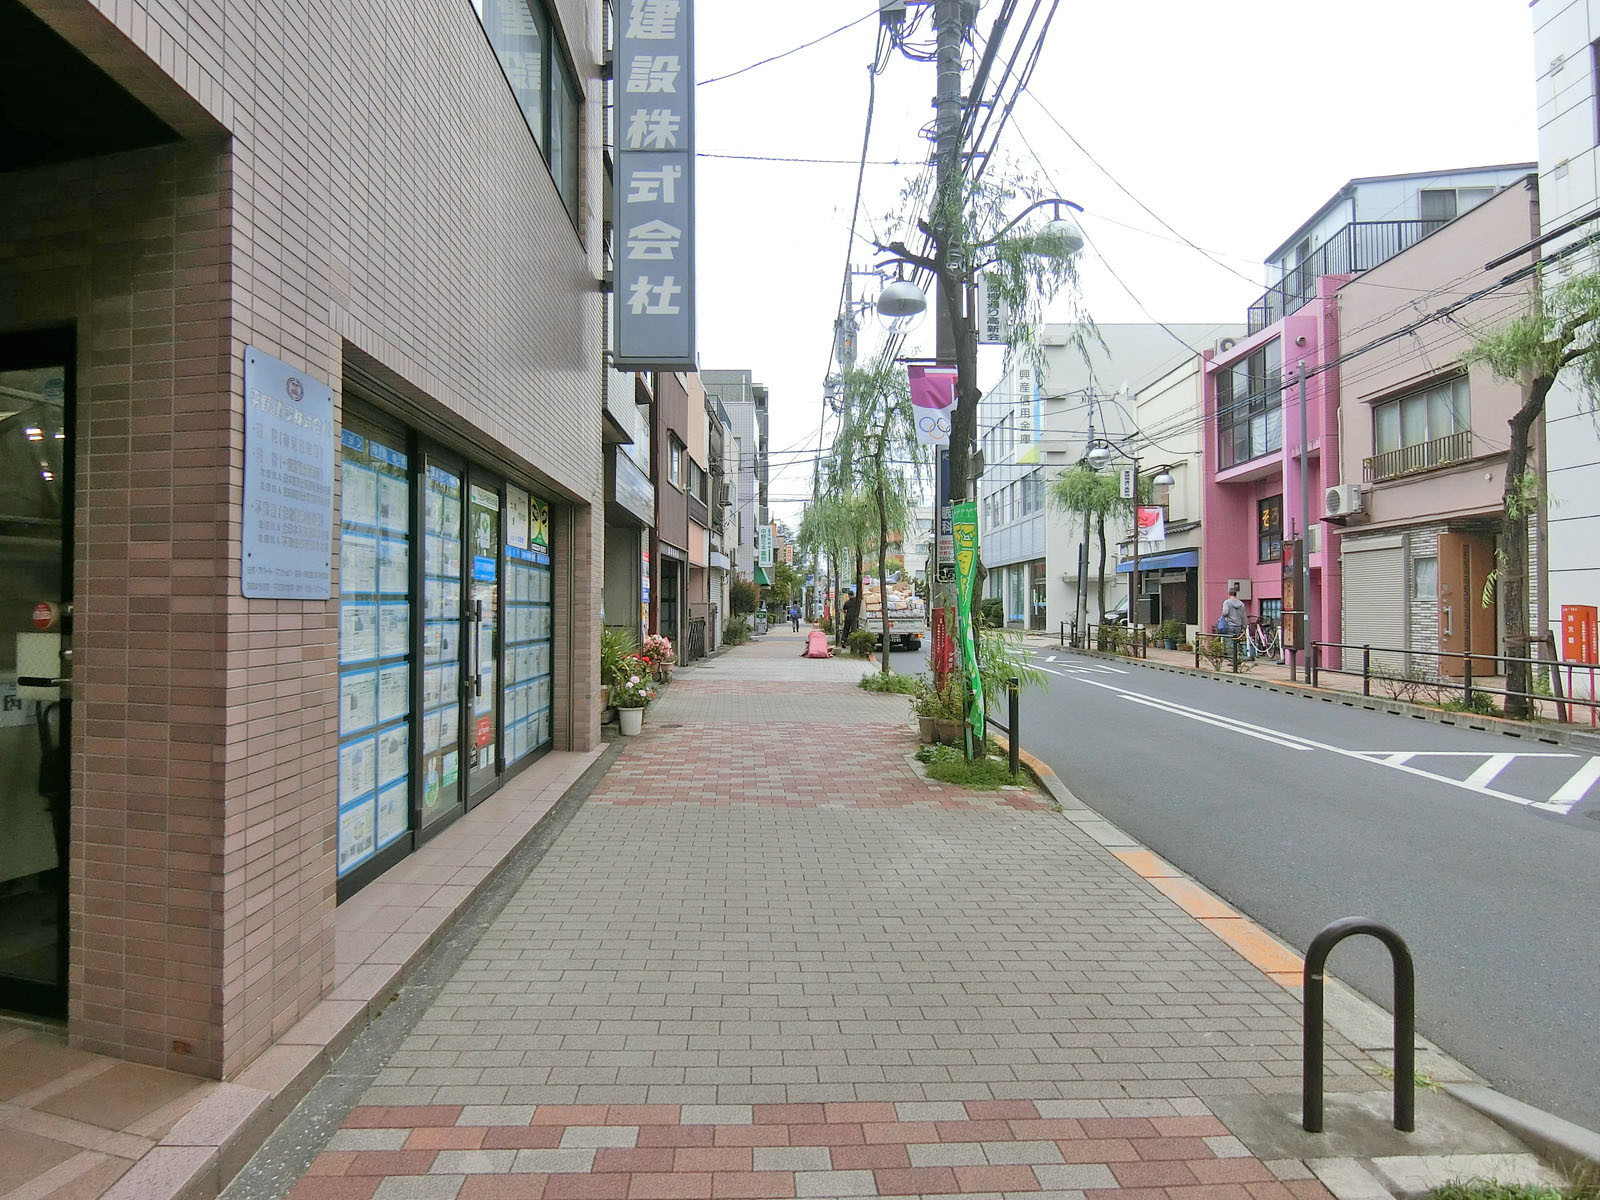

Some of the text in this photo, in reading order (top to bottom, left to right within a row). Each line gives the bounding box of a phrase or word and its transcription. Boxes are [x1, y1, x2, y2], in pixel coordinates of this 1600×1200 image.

[625, 0, 682, 315] 建設株式会社
[1018, 369, 1031, 444] 興産信用金庫
[1261, 508, 1279, 527] そろ
